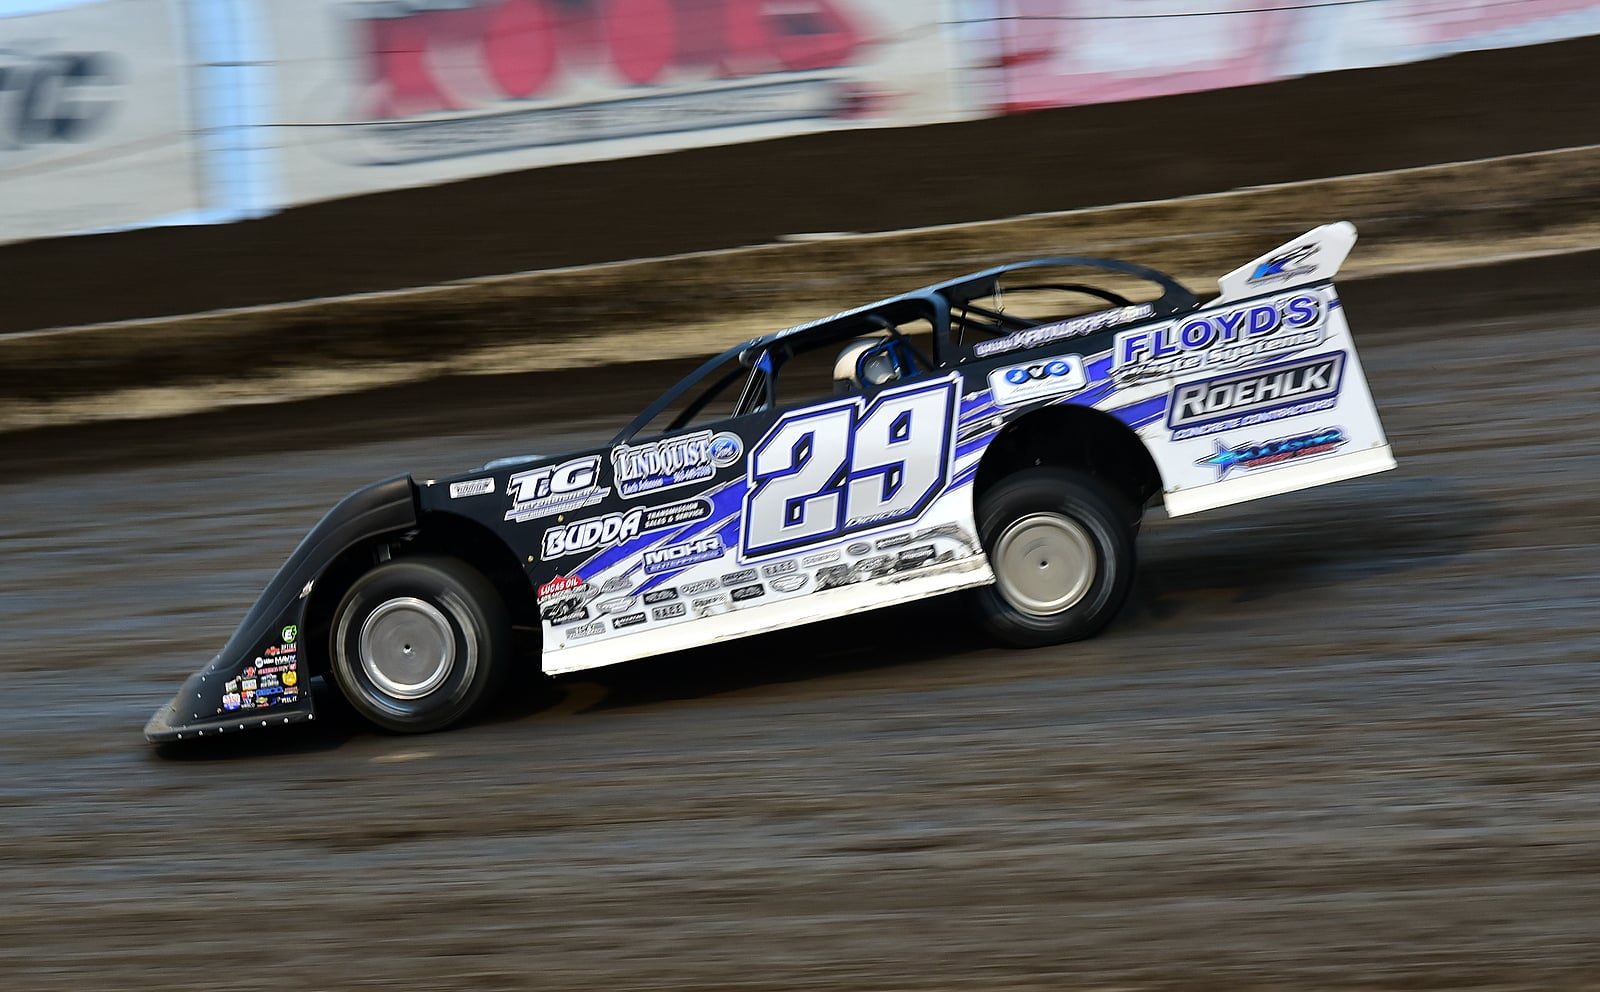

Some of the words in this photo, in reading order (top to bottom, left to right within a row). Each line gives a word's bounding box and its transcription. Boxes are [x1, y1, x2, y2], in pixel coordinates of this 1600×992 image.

[1182, 363, 1332, 417] ROEHLK
[618, 439, 711, 482] LINDQUIST
[740, 374, 960, 560] 29
[644, 516, 666, 528] SALES
[674, 507, 704, 521] SERVICE
[647, 501, 698, 520] TRANSMISSION
[546, 511, 642, 554] BUDDA
[645, 540, 720, 566] MOHR
[541, 580, 566, 596] LUCAS
[566, 577, 579, 590] OIL
